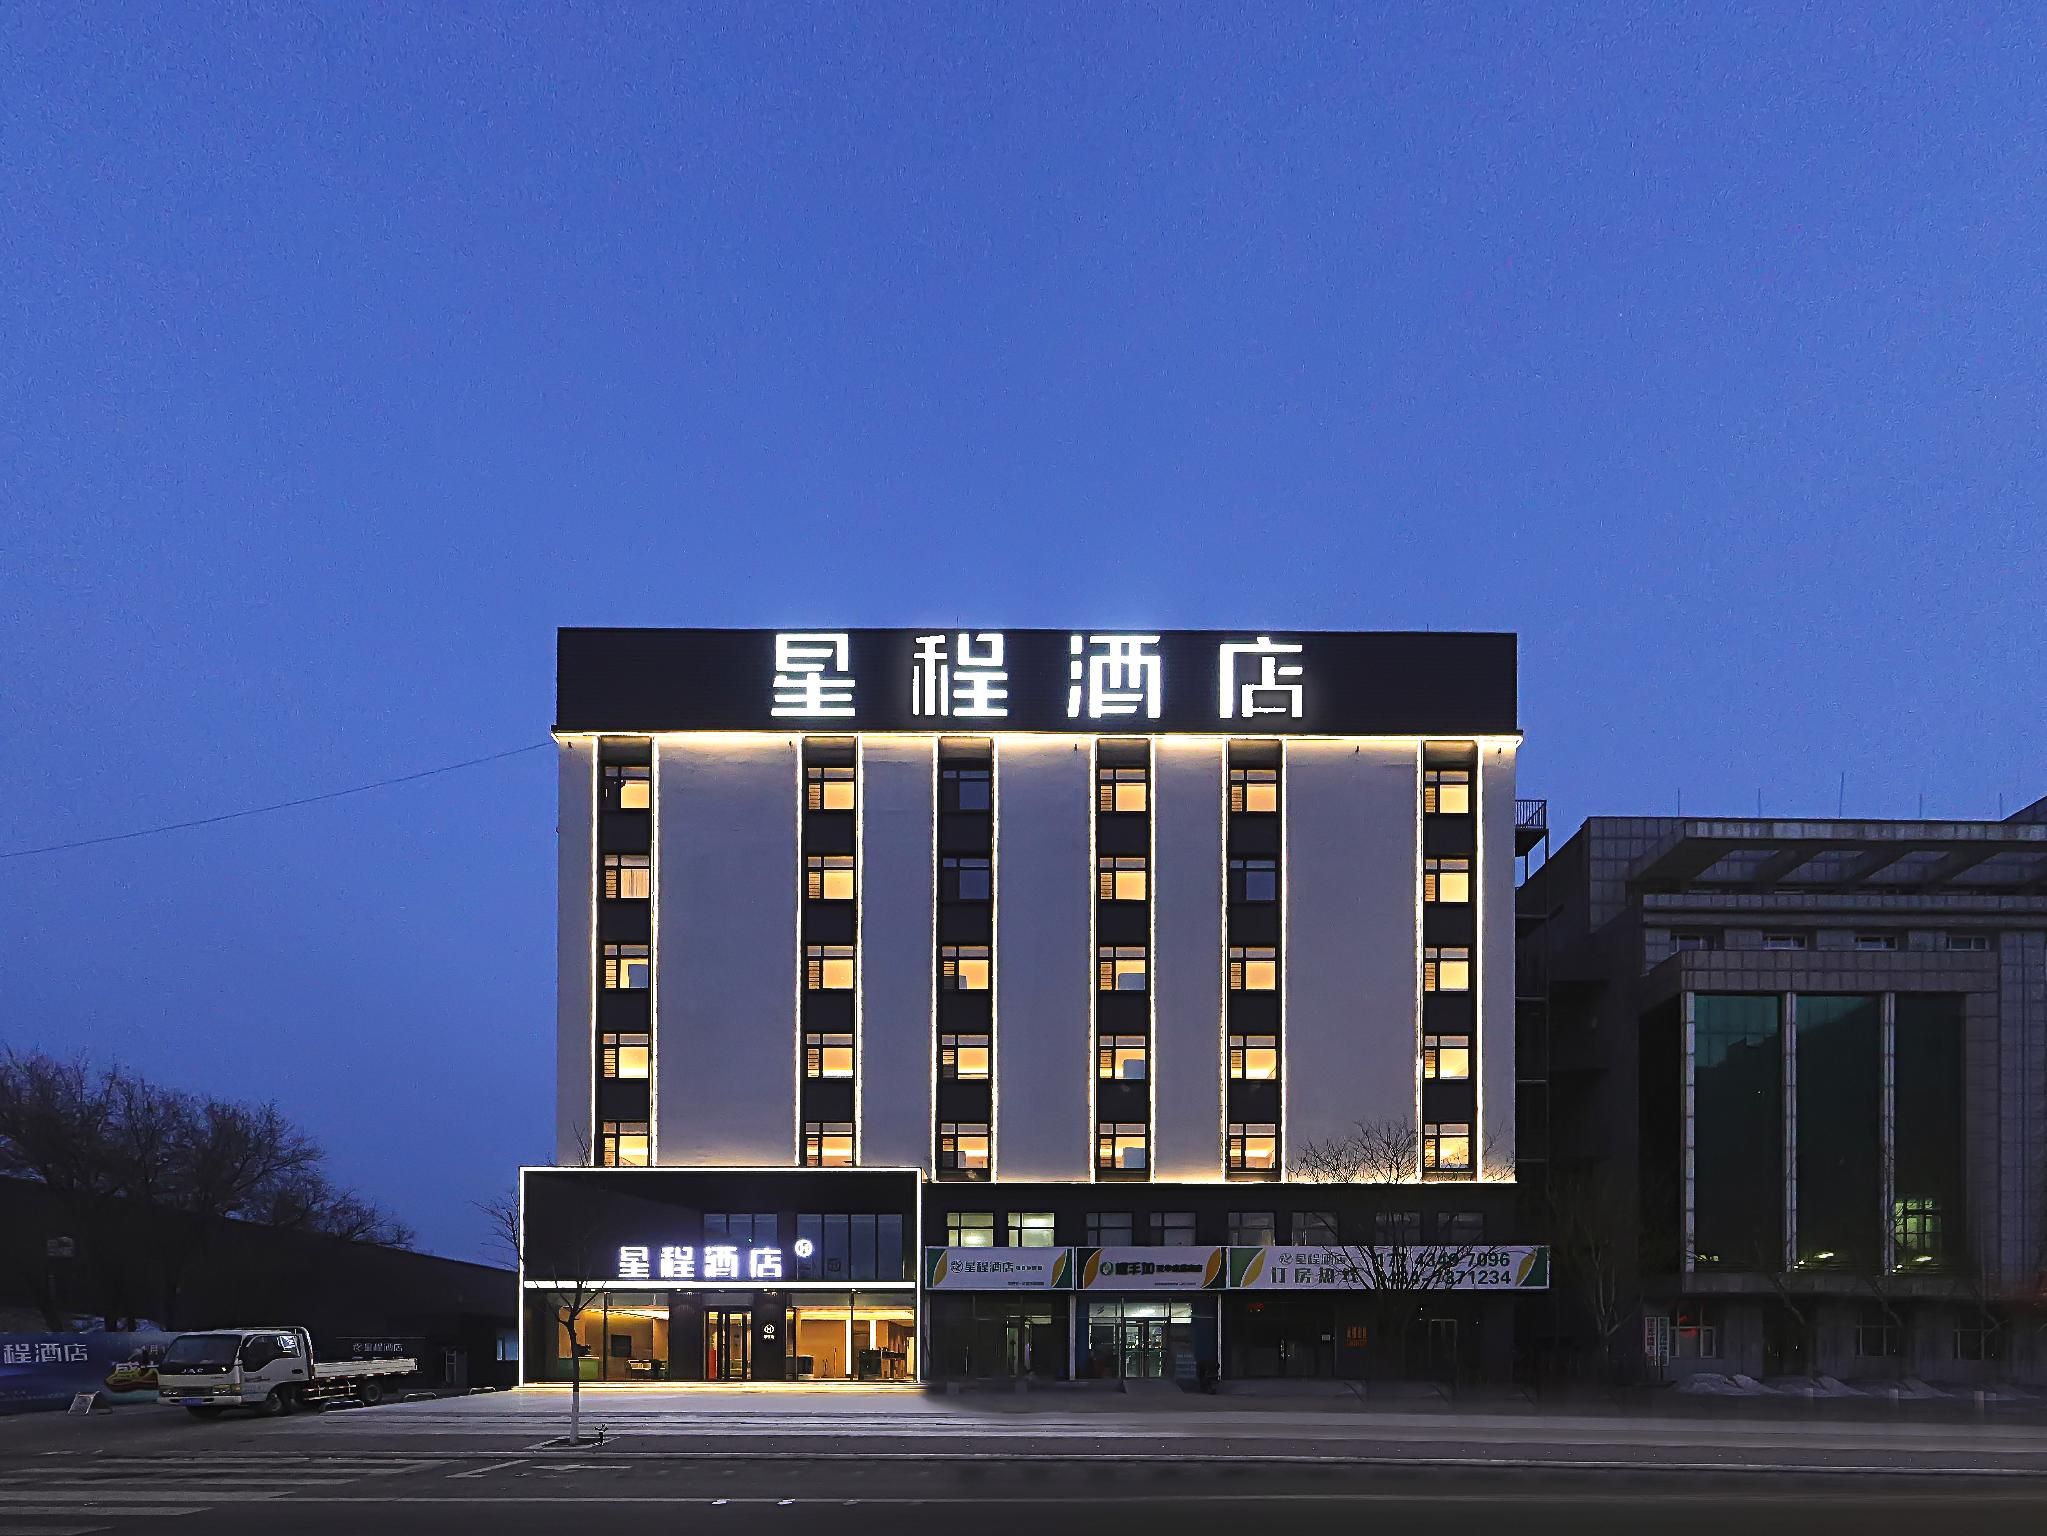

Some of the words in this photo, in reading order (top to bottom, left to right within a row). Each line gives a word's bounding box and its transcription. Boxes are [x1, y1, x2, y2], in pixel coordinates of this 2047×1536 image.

[771, 633, 1303, 718] 星程酒店
[618, 1246, 782, 1279] 星程酒店
[964, 1262, 1014, 1273] 星程酒店
[3, 1343, 89, 1364] 程酒店
